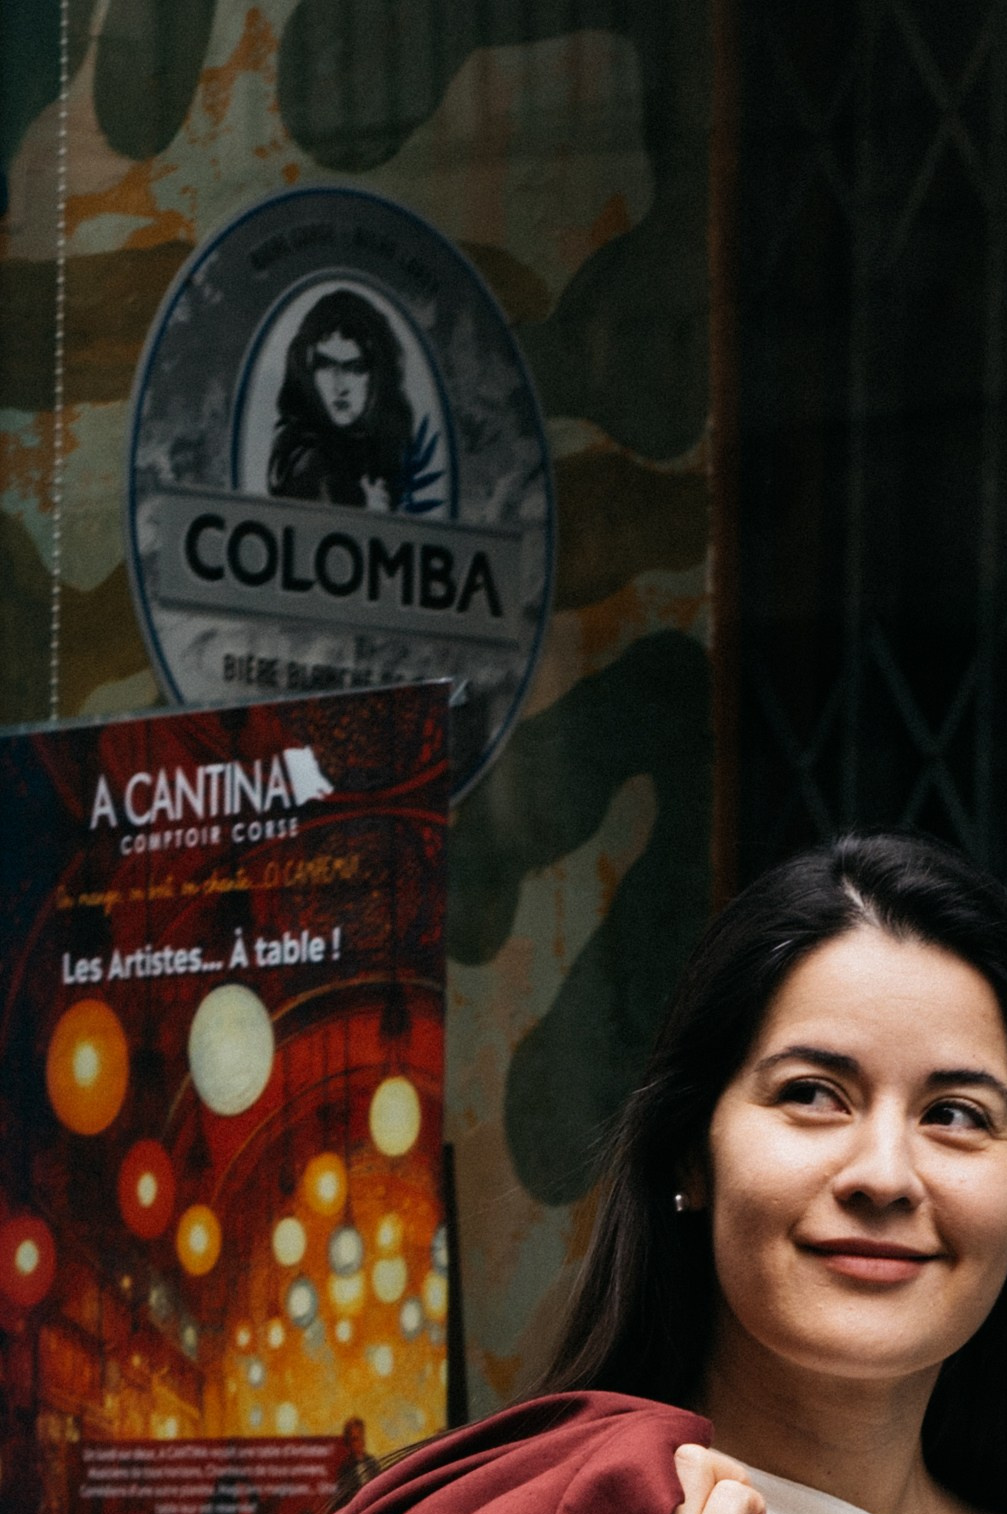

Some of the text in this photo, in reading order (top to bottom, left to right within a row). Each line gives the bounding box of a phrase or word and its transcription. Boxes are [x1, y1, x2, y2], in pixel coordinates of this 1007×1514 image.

[185, 512, 502, 618] COLOMBA
[90, 754, 292, 830] A CANTINA
[120, 817, 299, 855] COMPTOIR CORSE
[62, 952, 102, 985] Les
[230, 927, 249, 969] À
[255, 931, 326, 966] table
